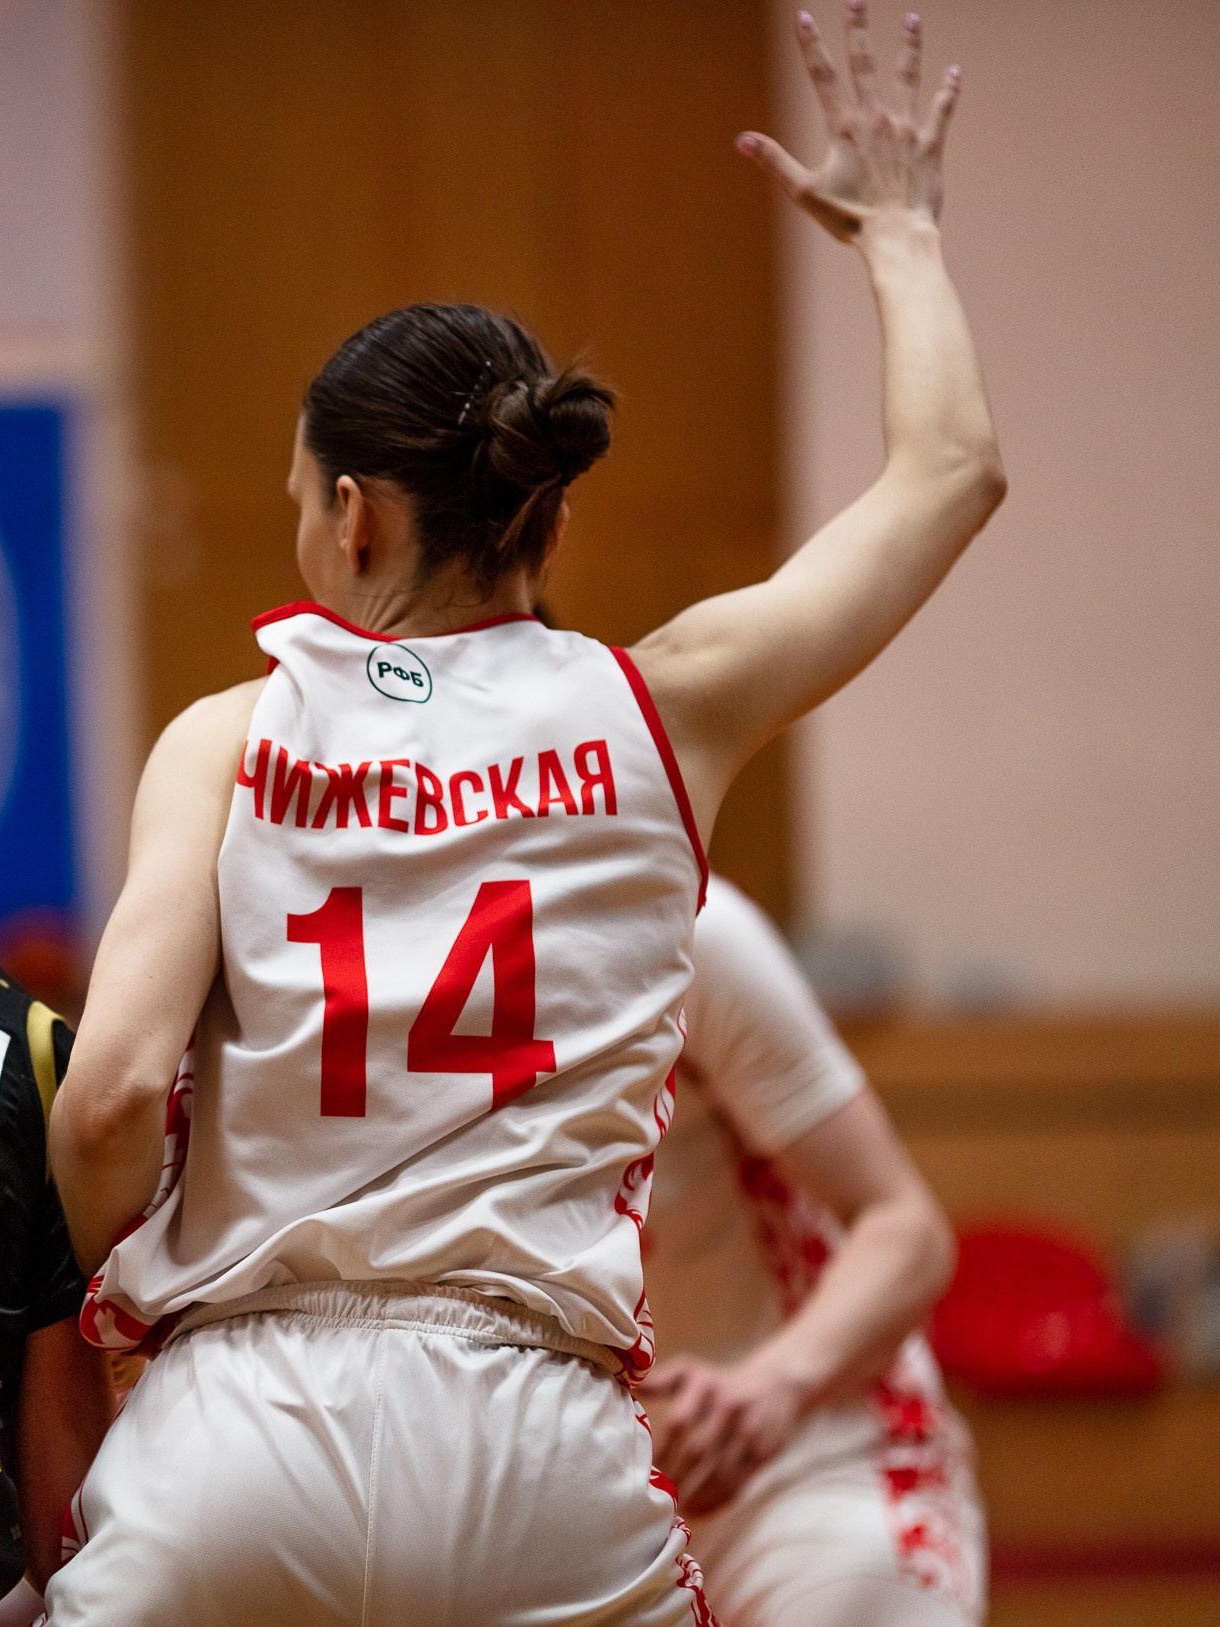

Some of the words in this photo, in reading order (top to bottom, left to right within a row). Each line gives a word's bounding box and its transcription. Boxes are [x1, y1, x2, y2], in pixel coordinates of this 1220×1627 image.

[377, 661, 424, 687] РФБ
[237, 738, 618, 835] ЧИЖЕВСКАЯ
[287, 879, 557, 1117] 14
